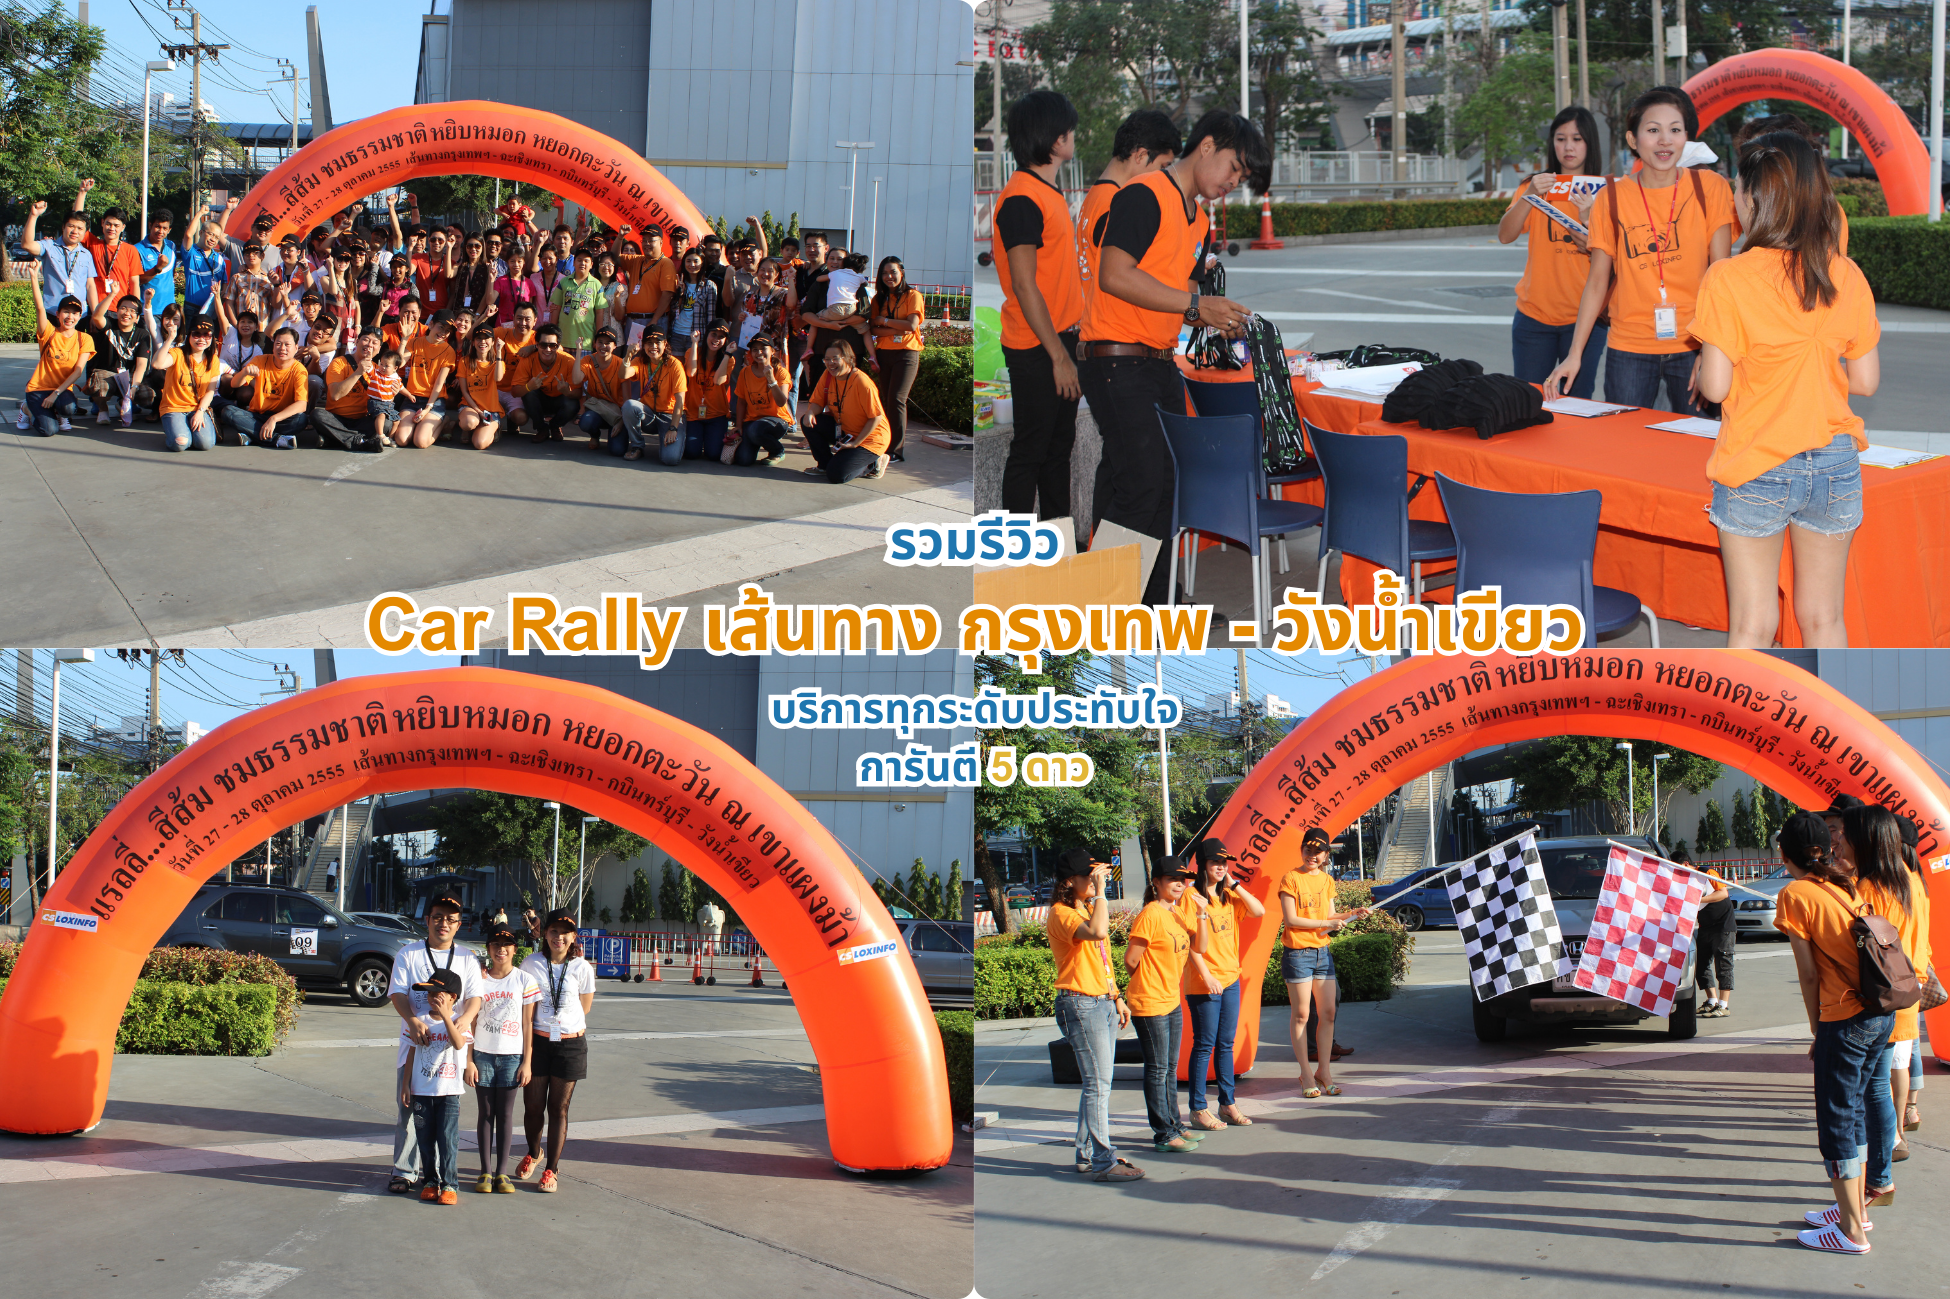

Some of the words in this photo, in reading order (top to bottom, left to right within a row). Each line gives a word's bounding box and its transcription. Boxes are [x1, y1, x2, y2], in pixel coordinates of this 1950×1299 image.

[320, 122, 428, 179] ชมธรรมชาติ
[430, 118, 526, 144] หยิบหมอก
[533, 133, 628, 188] หยอกตะวัน
[627, 183, 646, 202] ณ
[313, 199, 324, 210] 27
[330, 186, 343, 197] 28
[342, 167, 376, 191] ตุลาคม
[377, 159, 401, 174] 2555
[1549, 181, 1571, 194] CS
[1527, 196, 1588, 236] OXINFO
[1329, 792, 1345, 808] 27
[1353, 769, 1371, 787] 28
[1370, 738, 1418, 774] ตุลาคม
[1420, 721, 1455, 745] 2555
[1461, 696, 1590, 728] เส้นทางกรุงเทพฯ
[1606, 692, 1687, 719] ฉะเชิงเทรา
[1700, 711, 1781, 753] กบินทร์บุรี
[1788, 750, 1841, 800] วังน้ำเขีย
[1231, 752, 1337, 884] แรลลี่...สีส้ม
[1335, 660, 1492, 758] ชมธรรมชาติ
[1655, 661, 1808, 733] หยอกตะวัน
[1810, 725, 1839, 754] ณ
[90, 785, 214, 921] แรลลี่...สีส้ม
[213, 701, 388, 794] ชมธรรมชาติ
[392, 695, 551, 737] หยิบหมอก
[563, 718, 721, 806] หยอกตะวัน
[721, 800, 752, 831] ณ
[747, 824, 857, 948] เขาแผงม้า
[167, 834, 205, 871] วันที่
[202, 828, 221, 846] 27
[230, 807, 251, 826] 28
[250, 778, 304, 814] ตุลาคม
[306, 764, 345, 787] 2555
[353, 747, 492, 772] เส้นทางกรุงเทพฯ
[508, 749, 594, 782] ฉะเชิงเทรา
[607, 776, 691, 824] กบินทร์บุรี
[697, 824, 760, 889] วังน้ำเขียว
[1931, 859, 1943, 869] CS
[42, 914, 56, 922] CS
[55, 915, 97, 928] LOXINFO
[295, 937, 313, 948] 09
[839, 951, 853, 962] CS
[854, 943, 897, 958] LOXINFO
[484, 991, 514, 1002] DREAM
